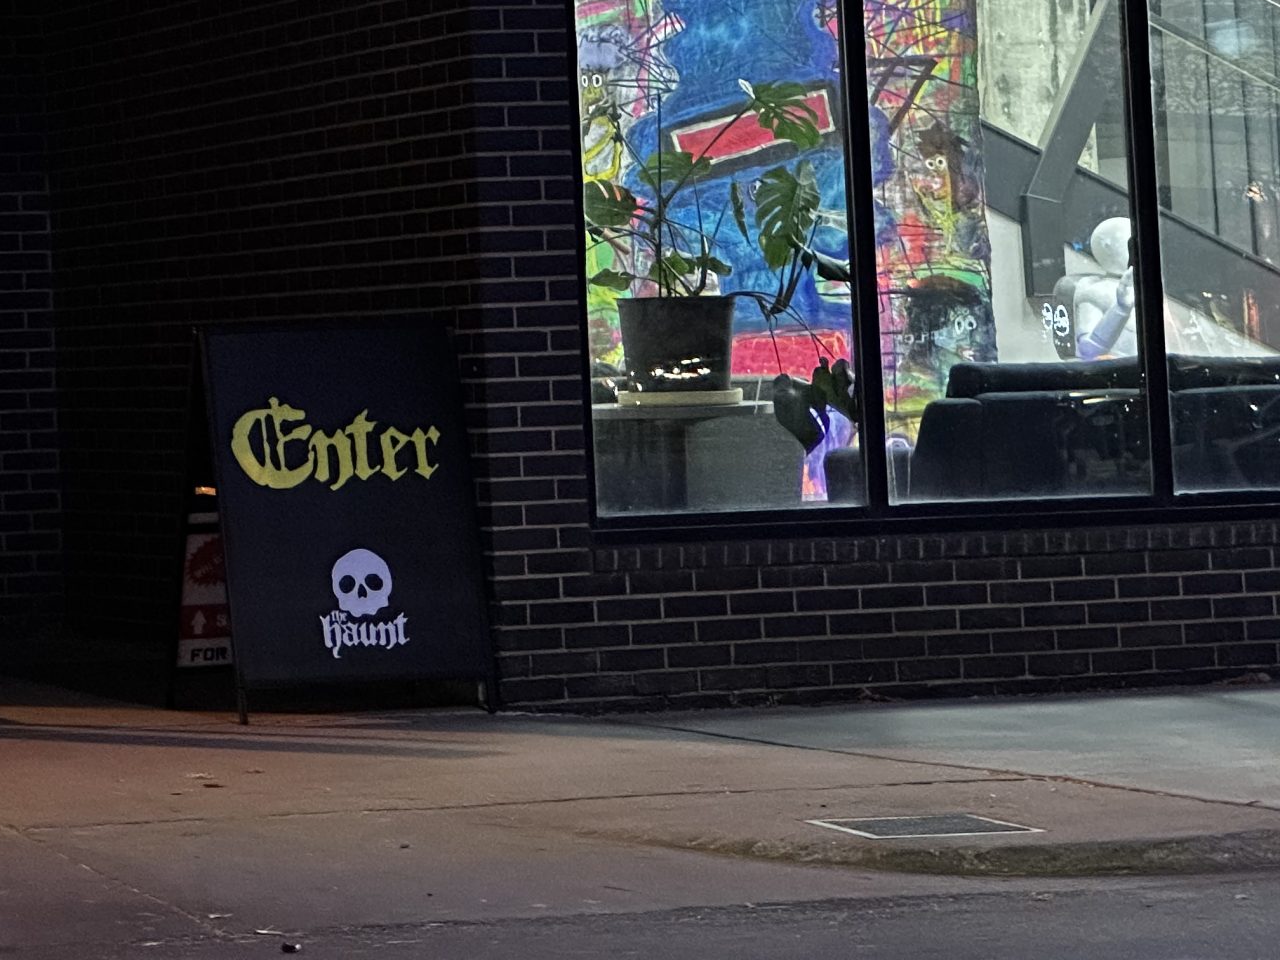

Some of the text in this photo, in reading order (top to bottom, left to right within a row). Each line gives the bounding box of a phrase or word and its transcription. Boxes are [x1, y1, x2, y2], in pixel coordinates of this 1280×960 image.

[230, 396, 441, 491] Enter
[191, 646, 227, 662] FOR
[319, 611, 411, 659] haunt
